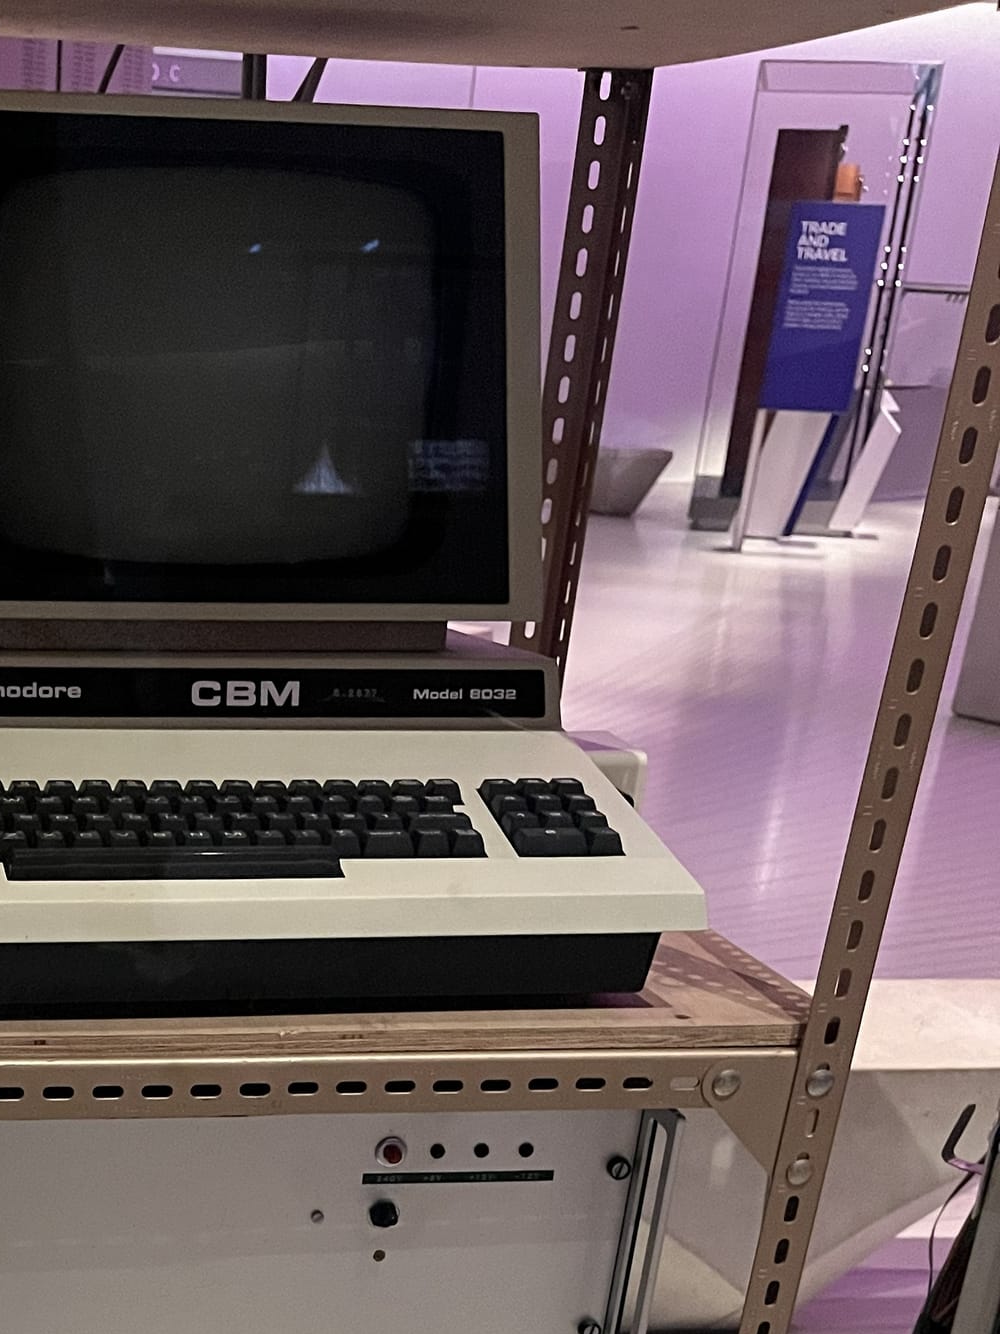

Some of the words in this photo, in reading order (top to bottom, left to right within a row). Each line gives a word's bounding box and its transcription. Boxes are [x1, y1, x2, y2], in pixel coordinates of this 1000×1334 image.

[801, 221, 848, 237] TRADE
[797, 234, 830, 249] AND
[796, 246, 848, 262] TRAVEL
[191, 680, 300, 707] CBM
[413, 688, 463, 700] Model
[469, 688, 517, 700] 8032
